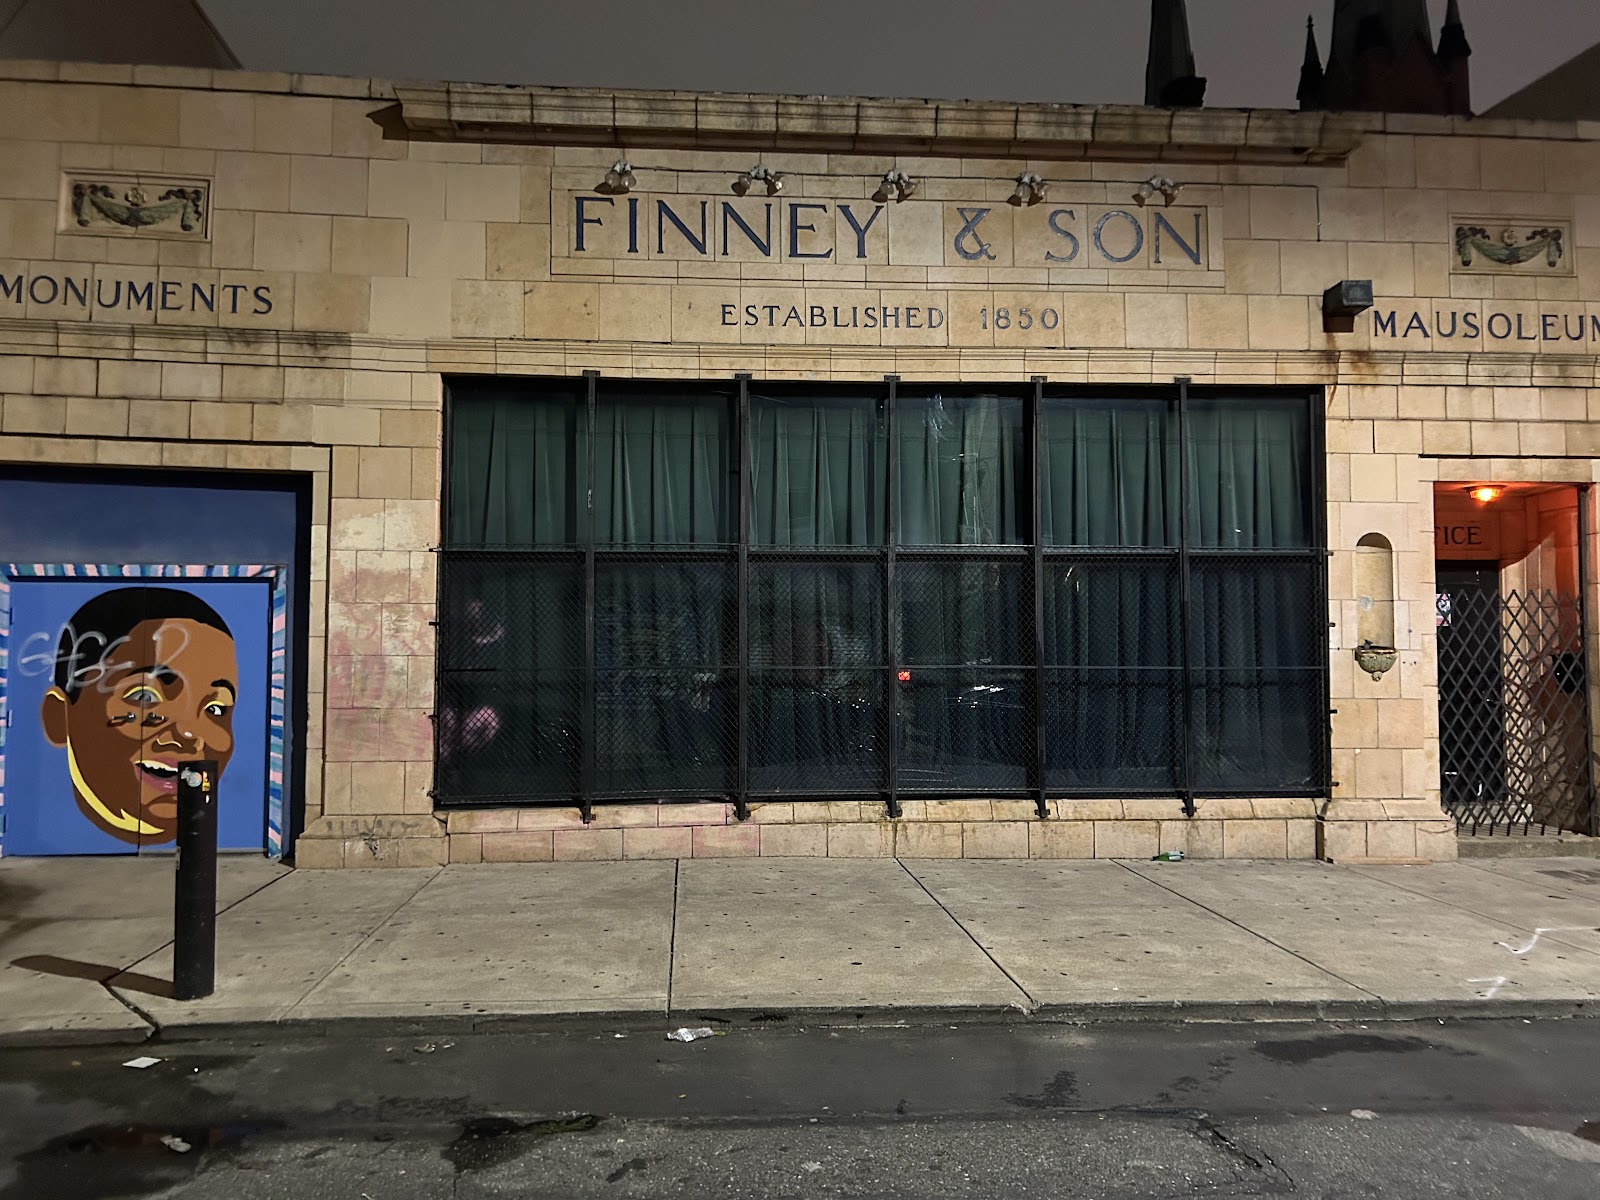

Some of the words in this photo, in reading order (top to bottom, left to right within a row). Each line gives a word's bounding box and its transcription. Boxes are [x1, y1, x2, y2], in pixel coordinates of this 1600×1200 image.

[575, 196, 884, 258] FINNEY
[953, 207, 997, 261] &
[1044, 209, 1202, 265] SON
[0, 273, 273, 315] MONUMENTS
[720, 304, 945, 329] ESTABLISHED
[980, 304, 1060, 330] 1850
